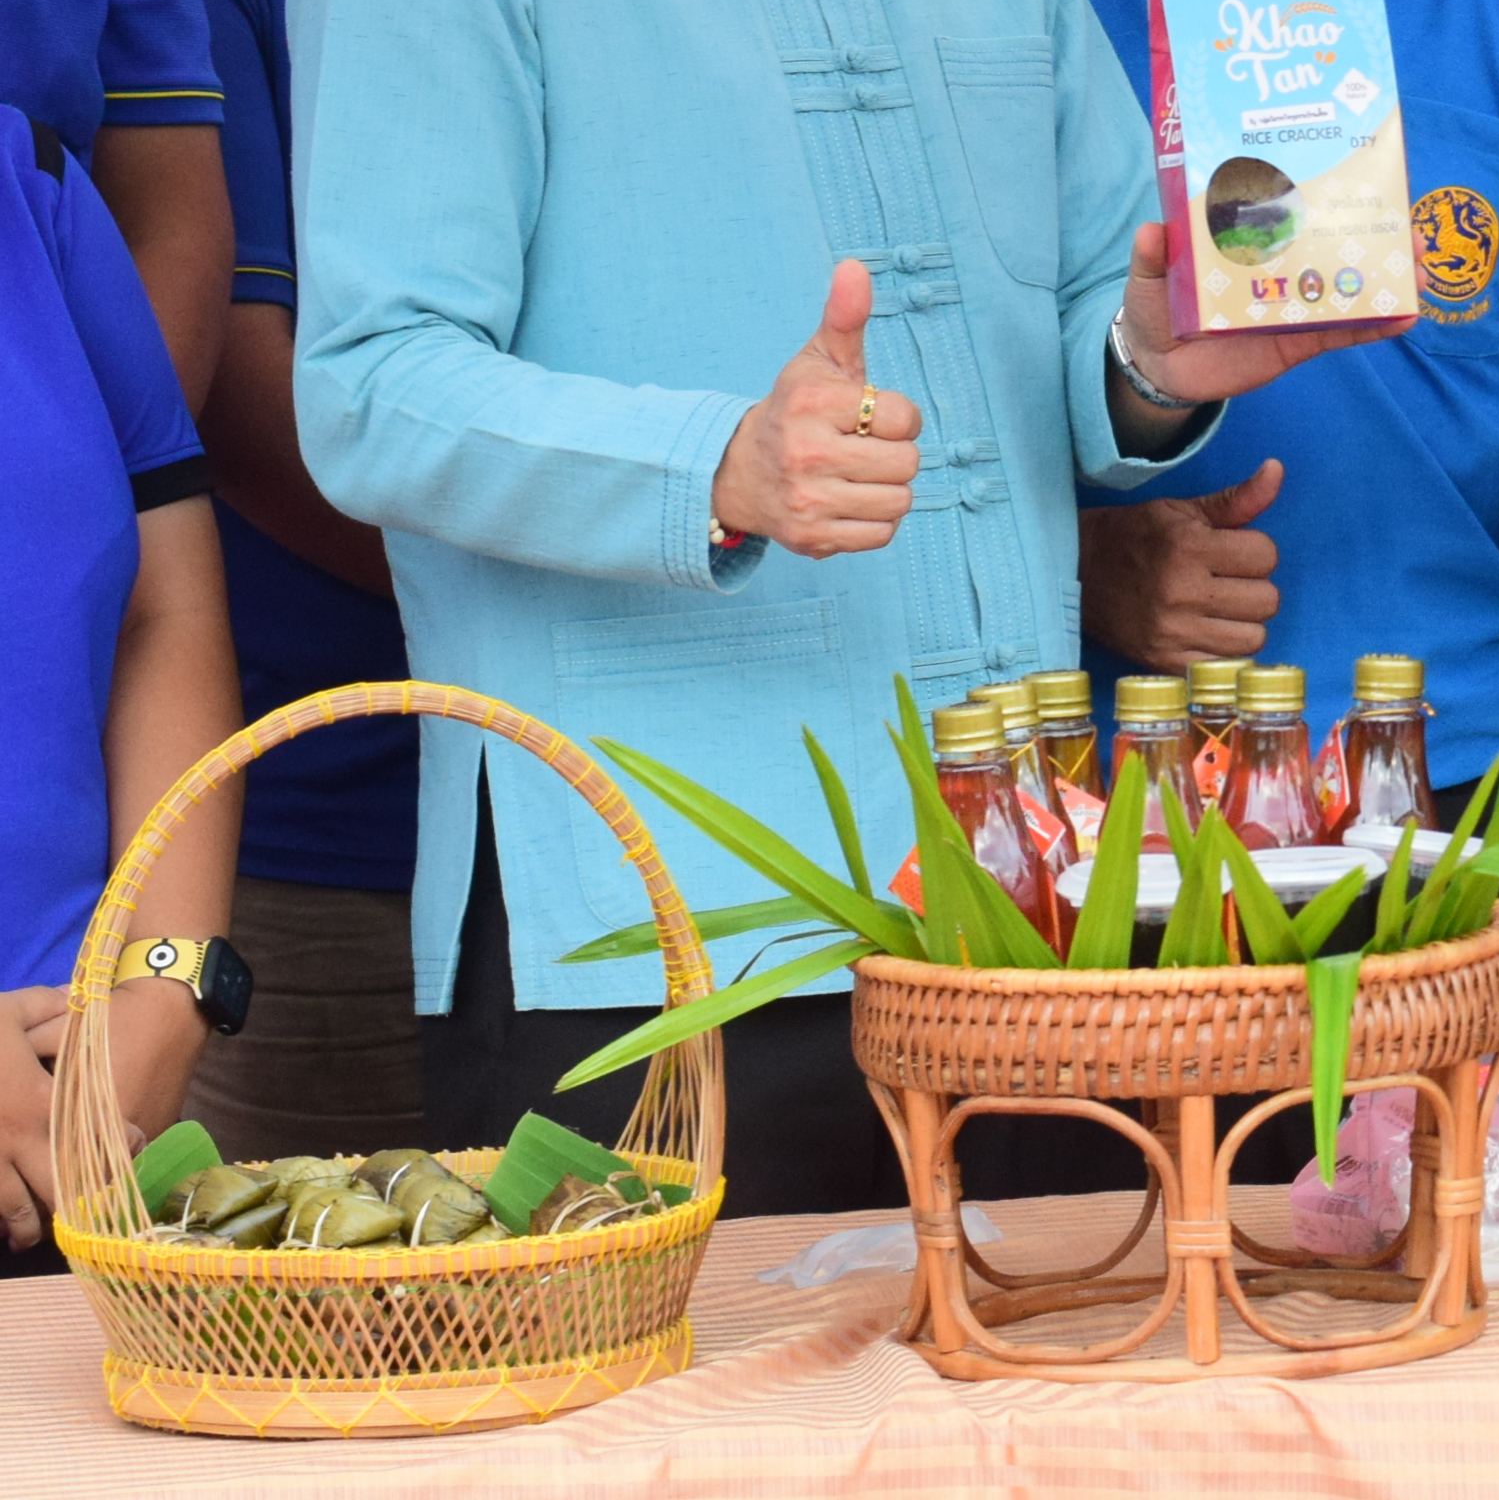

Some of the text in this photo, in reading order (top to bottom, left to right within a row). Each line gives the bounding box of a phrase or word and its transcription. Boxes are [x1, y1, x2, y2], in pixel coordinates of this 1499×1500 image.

[1225, 49, 1323, 102] Tan
[1242, 126, 1342, 145] RICE CRACKER
[1350, 135, 1377, 148] DIY
